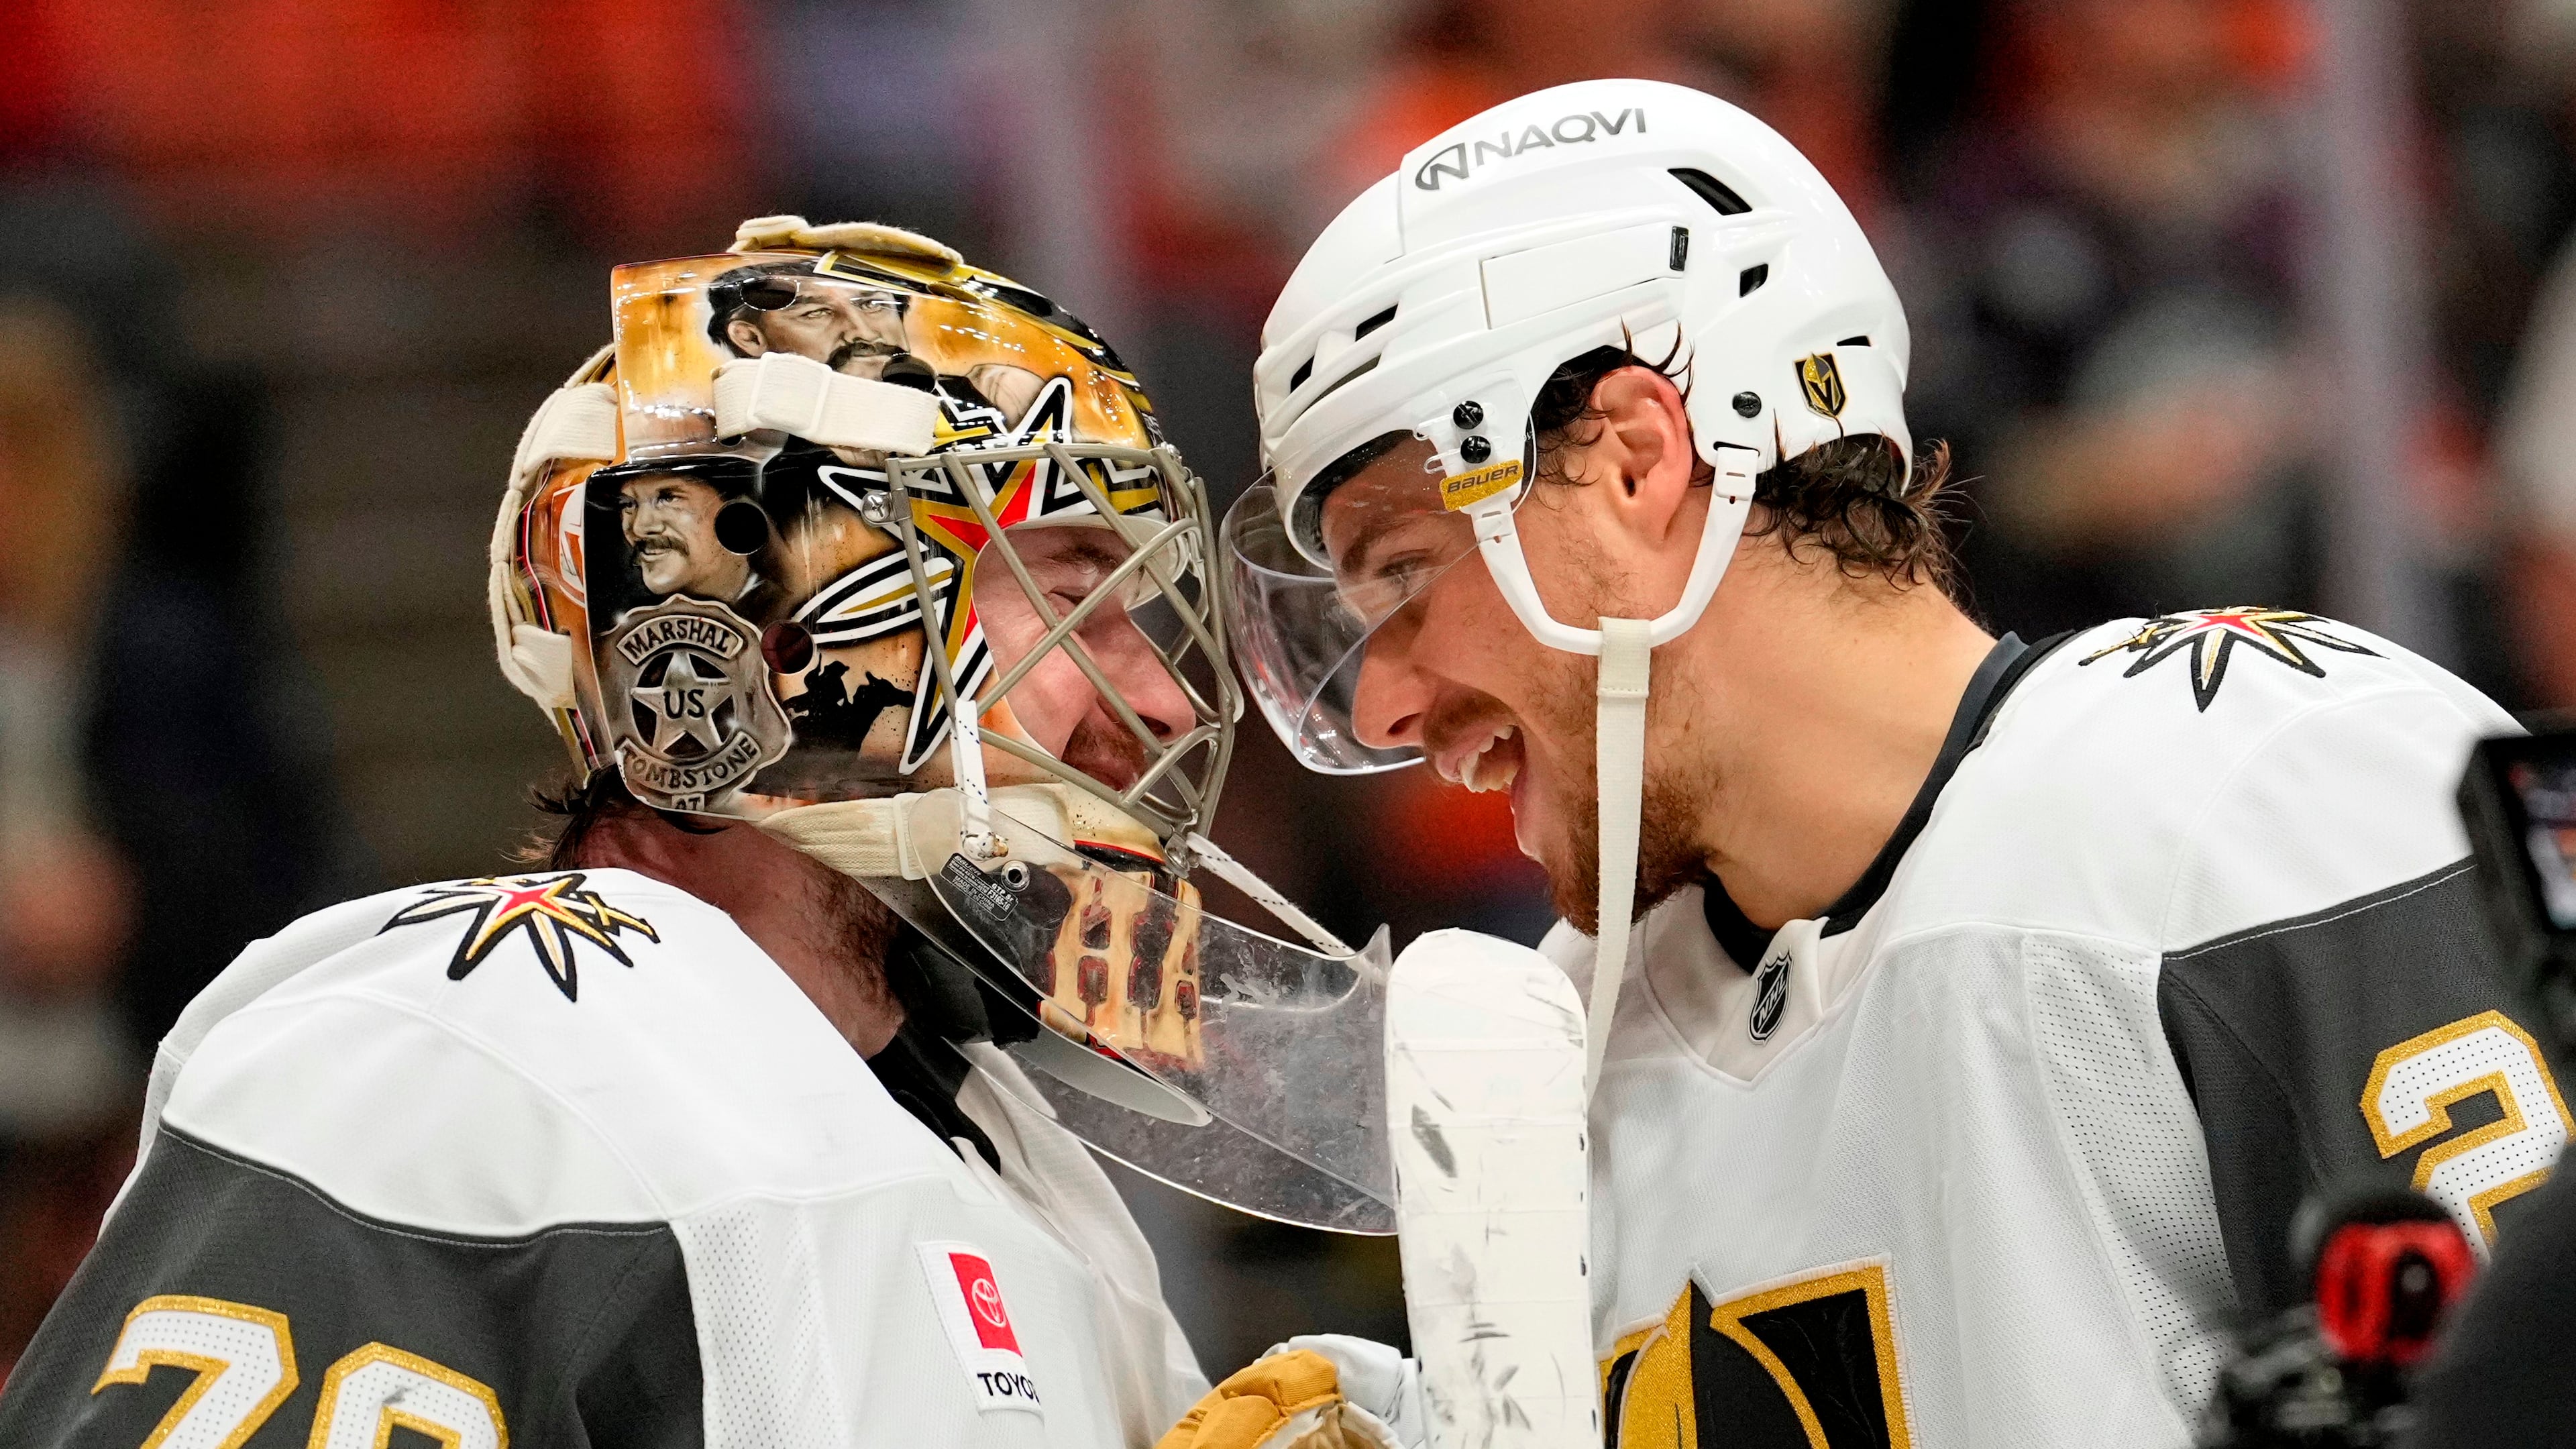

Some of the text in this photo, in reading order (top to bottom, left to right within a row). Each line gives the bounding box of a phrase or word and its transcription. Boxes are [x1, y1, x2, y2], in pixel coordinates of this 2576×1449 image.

[1474, 108, 1646, 166] NAQVI
[1447, 465, 1518, 493] BAUER
[623, 619, 729, 659] MARSHAL
[663, 688, 705, 718] US
[623, 737, 758, 788] TOMBSTONE
[954, 875, 972, 890] MADE
[977, 892, 995, 908] CHINA
[987, 890, 1011, 910] F3165-16
[991, 883, 1006, 896] GTP
[1006, 894, 1014, 902] Sr
[1757, 972, 1786, 1029] NHL
